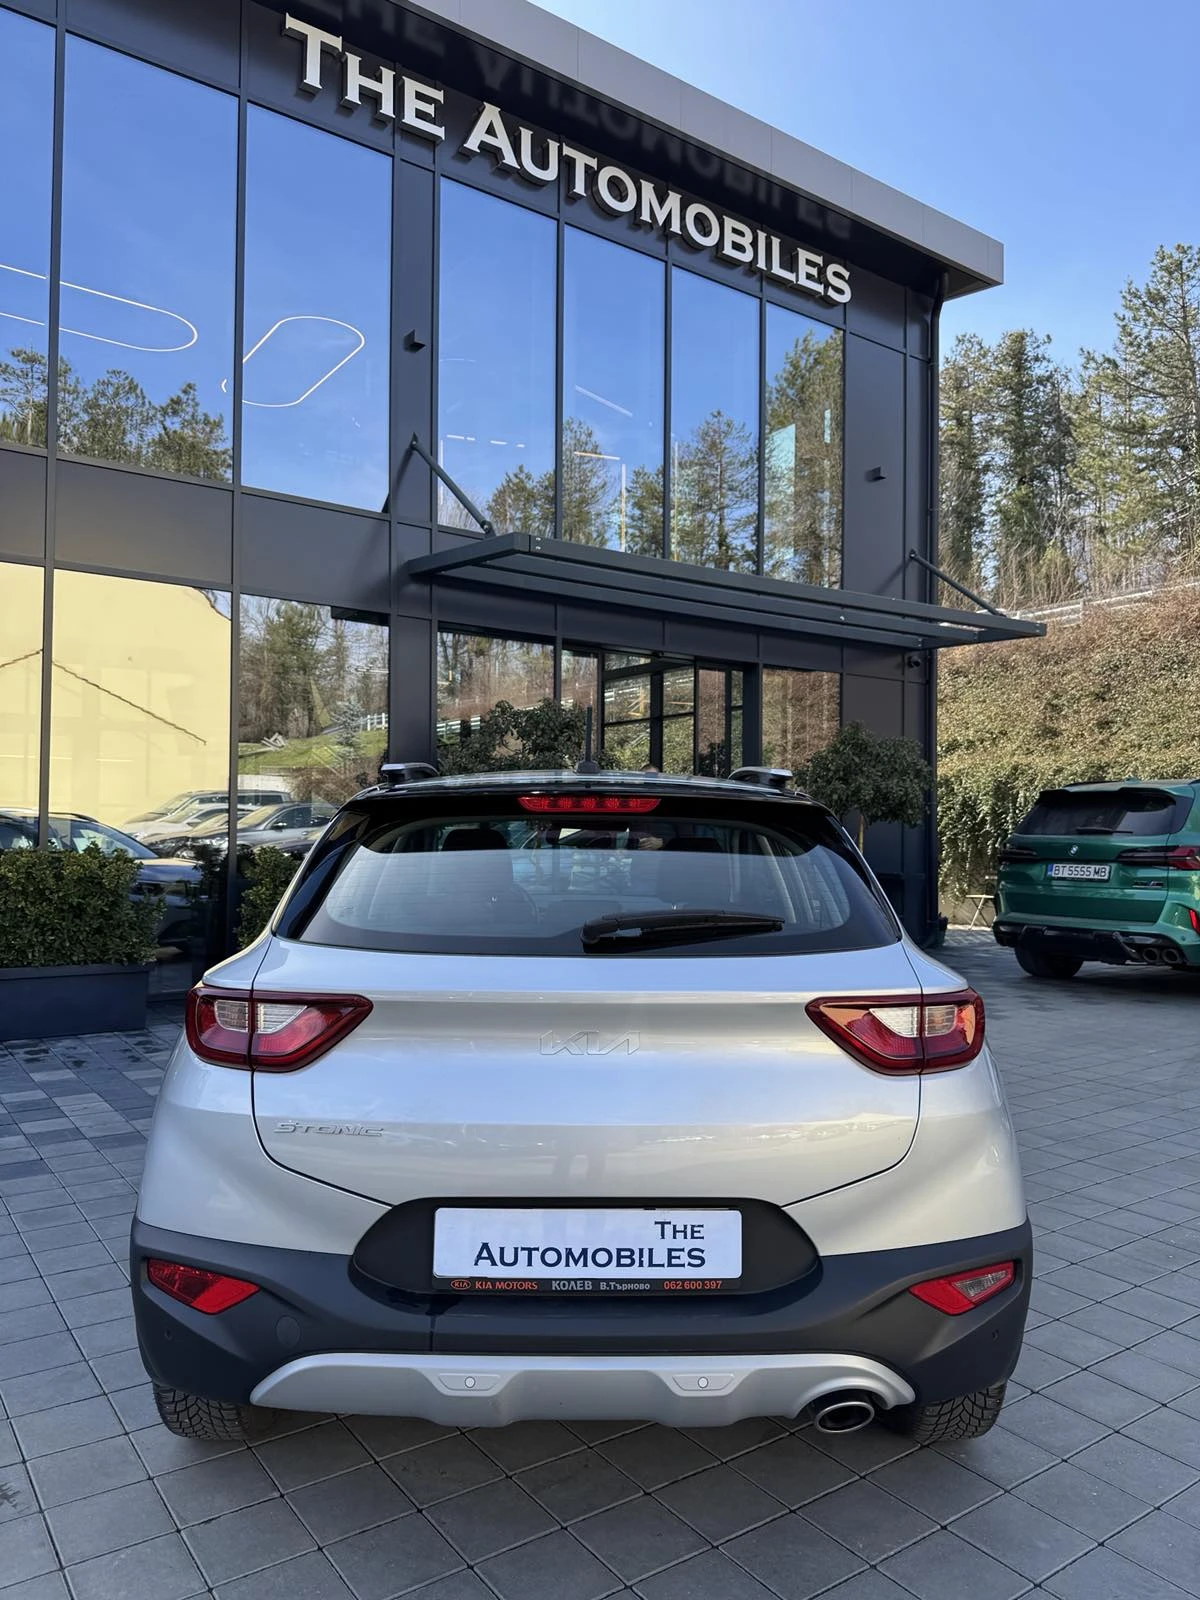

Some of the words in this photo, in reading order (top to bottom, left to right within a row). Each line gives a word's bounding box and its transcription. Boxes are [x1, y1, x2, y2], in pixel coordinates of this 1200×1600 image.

[282, 12, 446, 142] THE
[462, 101, 852, 304] AUTOMOBILES
[1067, 865, 1092, 877] 5555
[1092, 866, 1107, 878] MB
[274, 1121, 384, 1137] STONIC
[654, 1220, 705, 1240] THE
[473, 1242, 706, 1268] AUTOMOBILES
[450, 1279, 471, 1291] KIA
[475, 1281, 493, 1290] KIA
[495, 1281, 538, 1290] MOTORS
[551, 1280, 593, 1291] КОЛЕВ
[663, 1281, 682, 1290] 062
[683, 1281, 702, 1290] 600
[704, 1281, 722, 1290] 397
